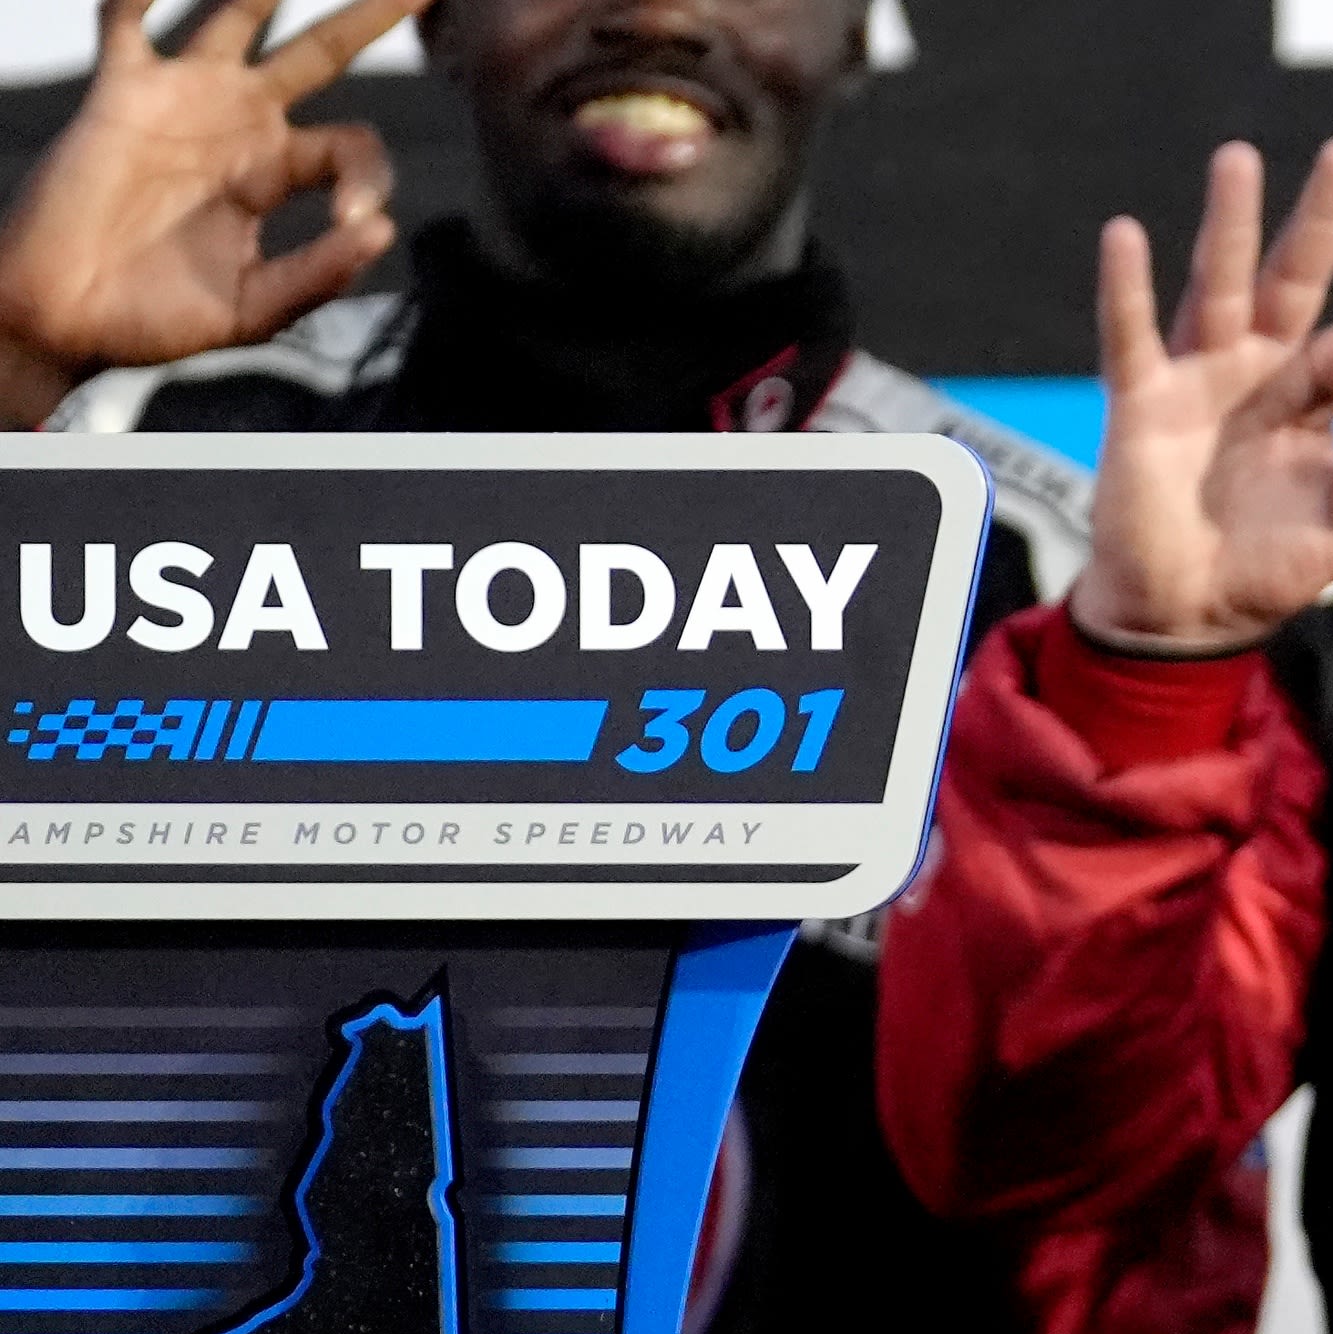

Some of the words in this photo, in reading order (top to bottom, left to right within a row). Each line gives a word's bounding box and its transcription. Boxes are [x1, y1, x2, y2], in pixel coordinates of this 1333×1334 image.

[19, 541, 329, 652] USA
[360, 541, 880, 652] TODAY
[615, 687, 846, 774] 301
[8, 821, 262, 845] AMPSHIRE
[293, 821, 465, 845] MOTOR
[493, 821, 766, 846] SPEEDWAY
